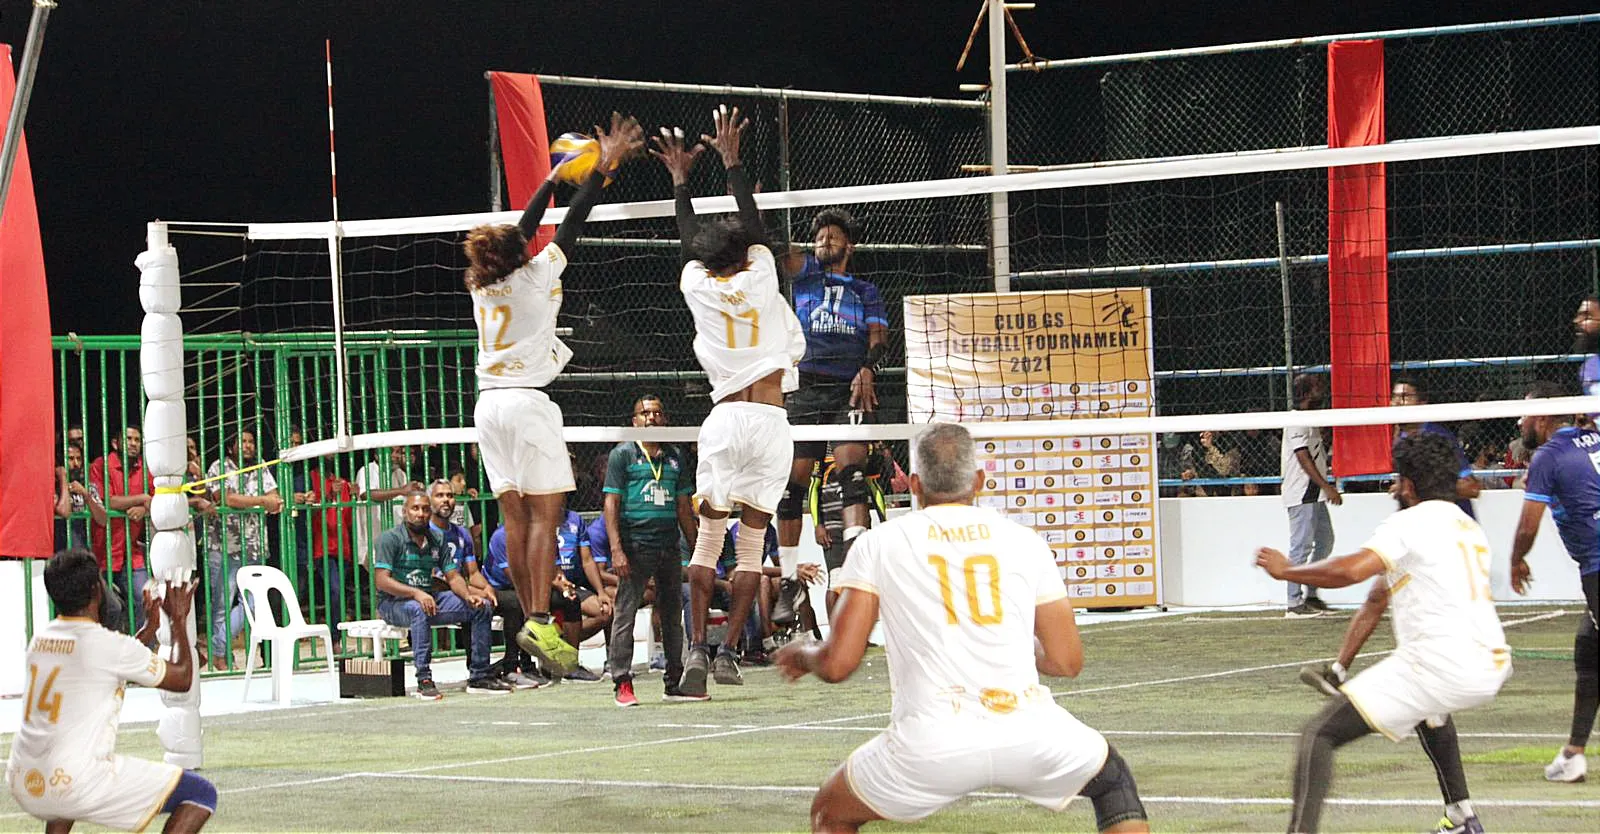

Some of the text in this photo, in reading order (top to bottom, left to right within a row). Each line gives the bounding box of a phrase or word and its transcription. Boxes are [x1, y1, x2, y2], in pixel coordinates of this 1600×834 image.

[824, 285, 844, 312] 17
[479, 304, 517, 353] 12
[719, 307, 759, 349] 17
[995, 312, 1063, 330] CLUB GS
[1025, 330, 1139, 351] TOURNAMENT
[1011, 355, 1051, 373] 2021
[927, 523, 992, 543] AHMED
[927, 553, 1004, 626] 10
[24, 663, 64, 725] 14
